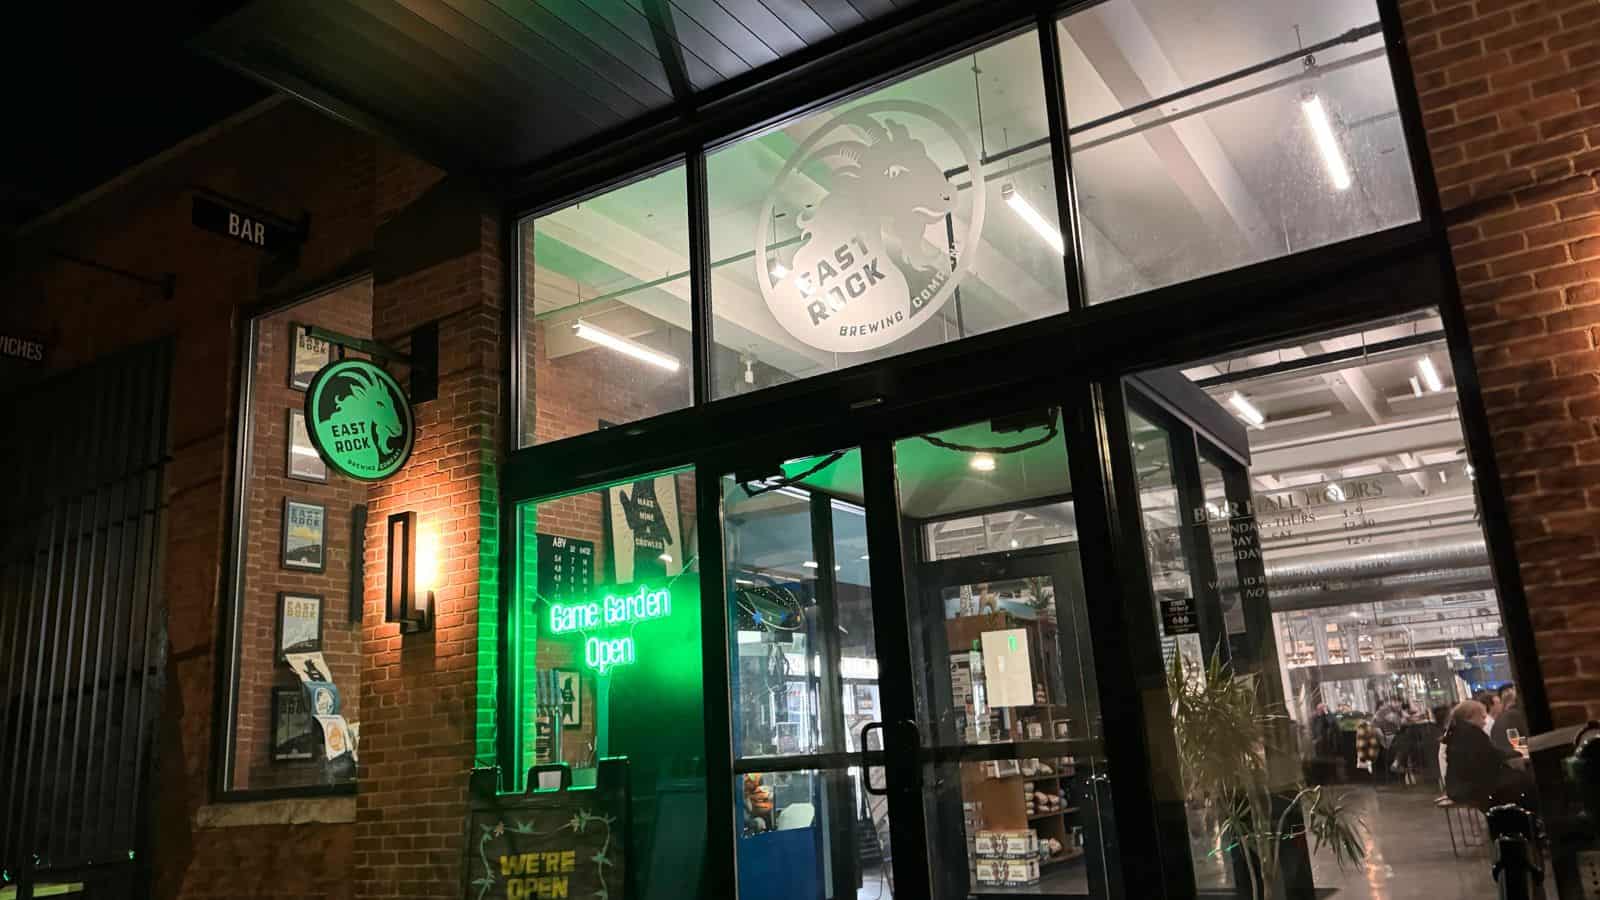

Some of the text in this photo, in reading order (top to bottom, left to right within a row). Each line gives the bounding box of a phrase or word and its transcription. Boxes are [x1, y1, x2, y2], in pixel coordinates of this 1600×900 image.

[228, 212, 265, 246] BAR
[796, 234, 870, 300] EAST
[839, 309, 905, 338] BREWING
[331, 421, 366, 438] EAST
[335, 436, 371, 453] ROCK
[1193, 501, 1242, 523] BER
[552, 537, 567, 548] ABV
[550, 585, 672, 632] Game Garden
[585, 637, 636, 674] Open
[500, 850, 576, 876] WE'RE
[507, 876, 569, 900] OPEN
